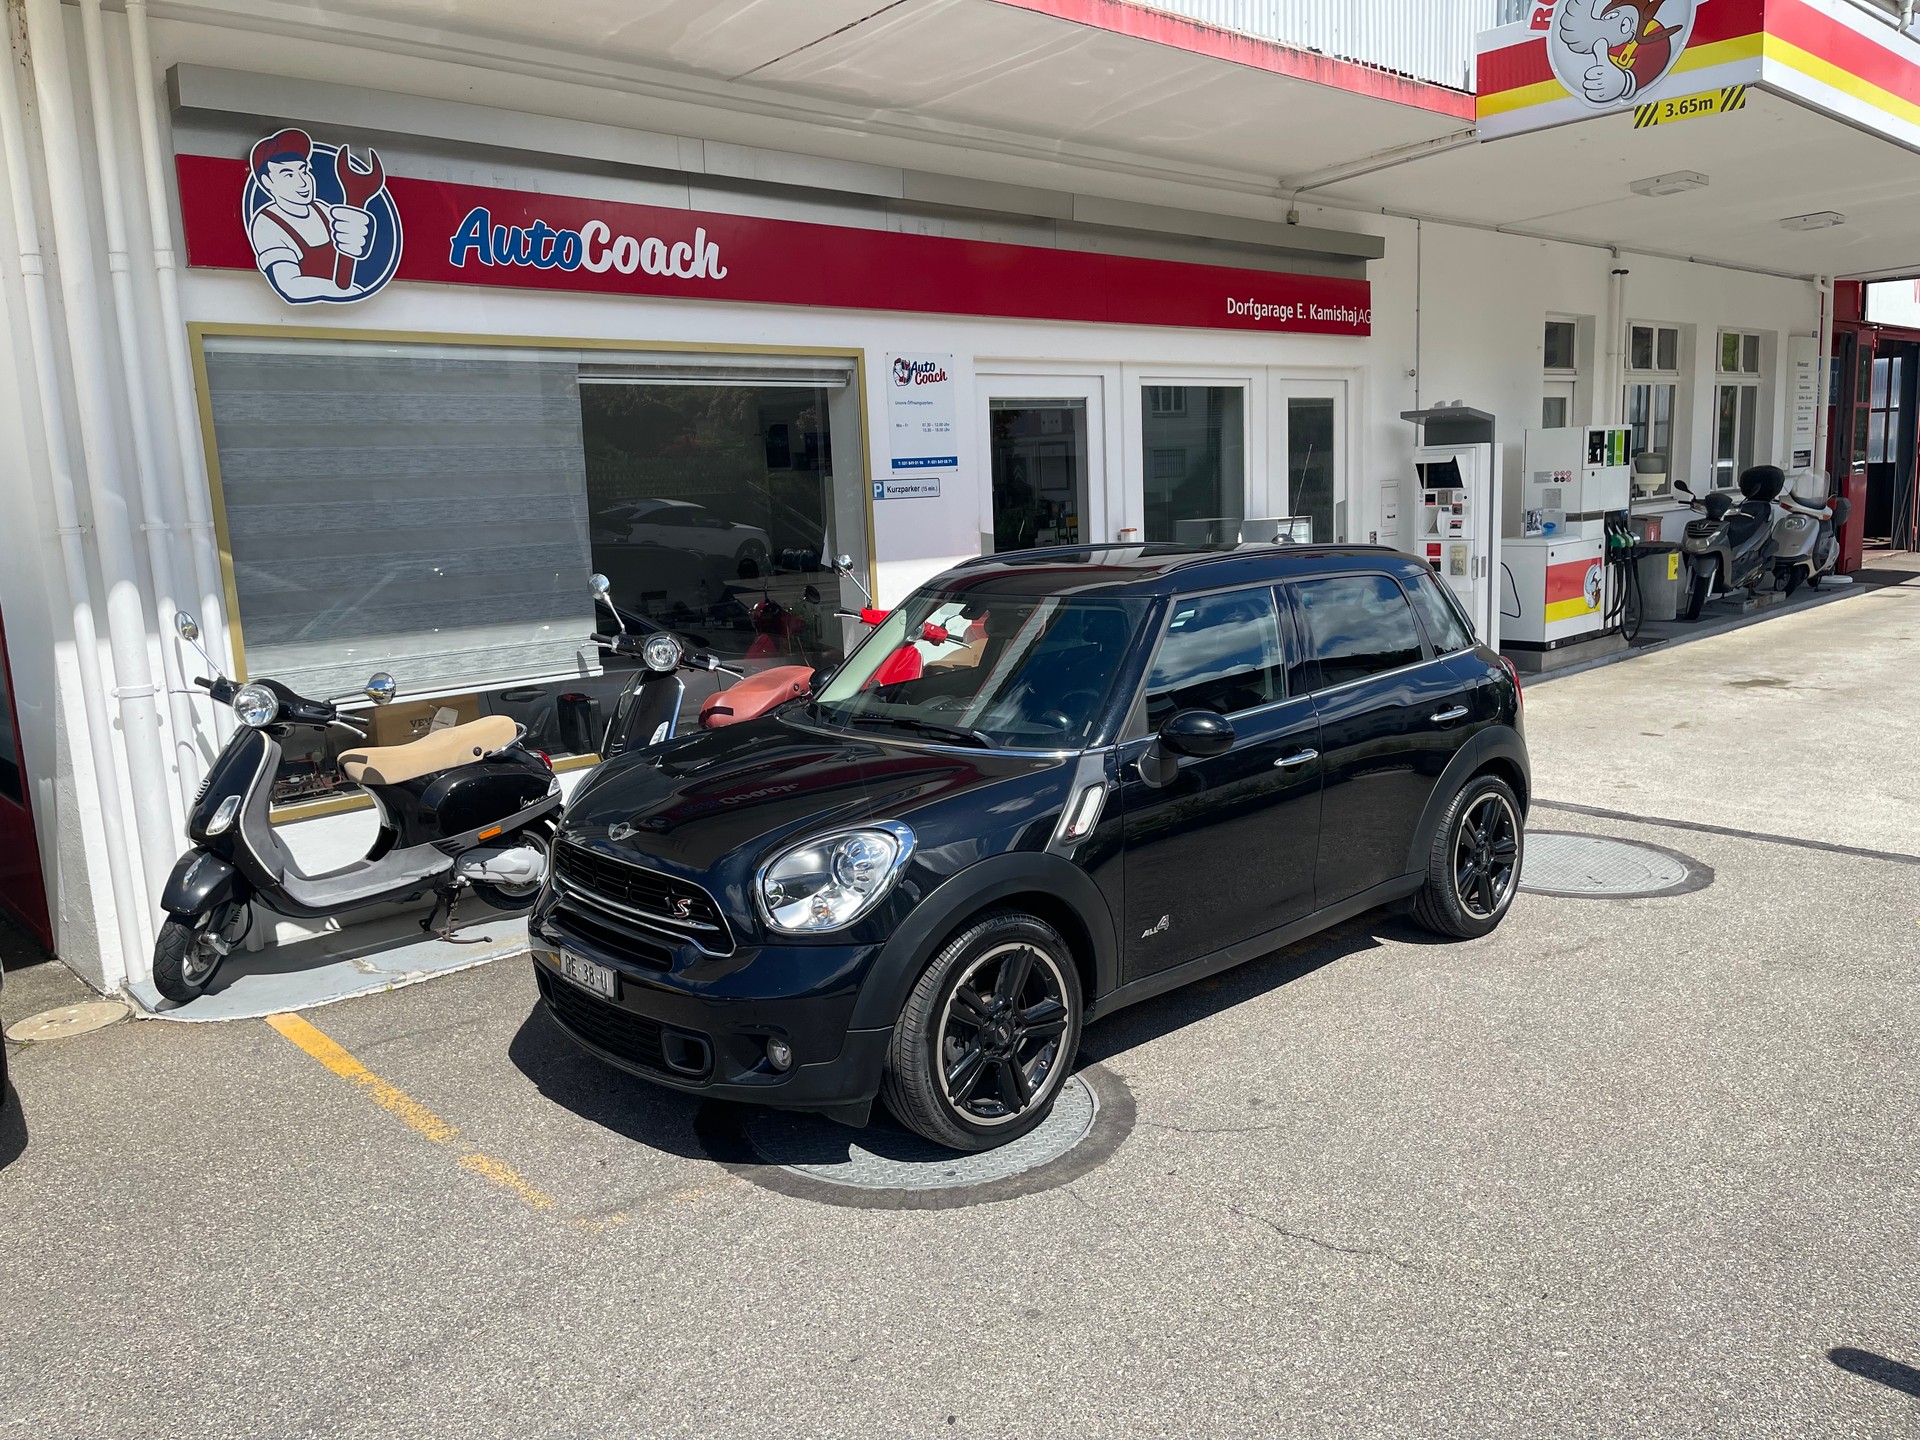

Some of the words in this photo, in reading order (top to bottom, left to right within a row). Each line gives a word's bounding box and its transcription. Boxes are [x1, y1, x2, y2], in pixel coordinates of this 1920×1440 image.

[1665, 97, 1713, 117] 3.65m
[450, 207, 728, 280] AutoCoach
[1227, 297, 1293, 322] Dorfgarage
[1297, 303, 1306, 319] E.
[911, 361, 935, 375] Auto
[915, 368, 948, 385] Coach
[1595, 448, 1601, 461] 1
[873, 483, 882, 498] P
[887, 485, 920, 494] Kurzparker
